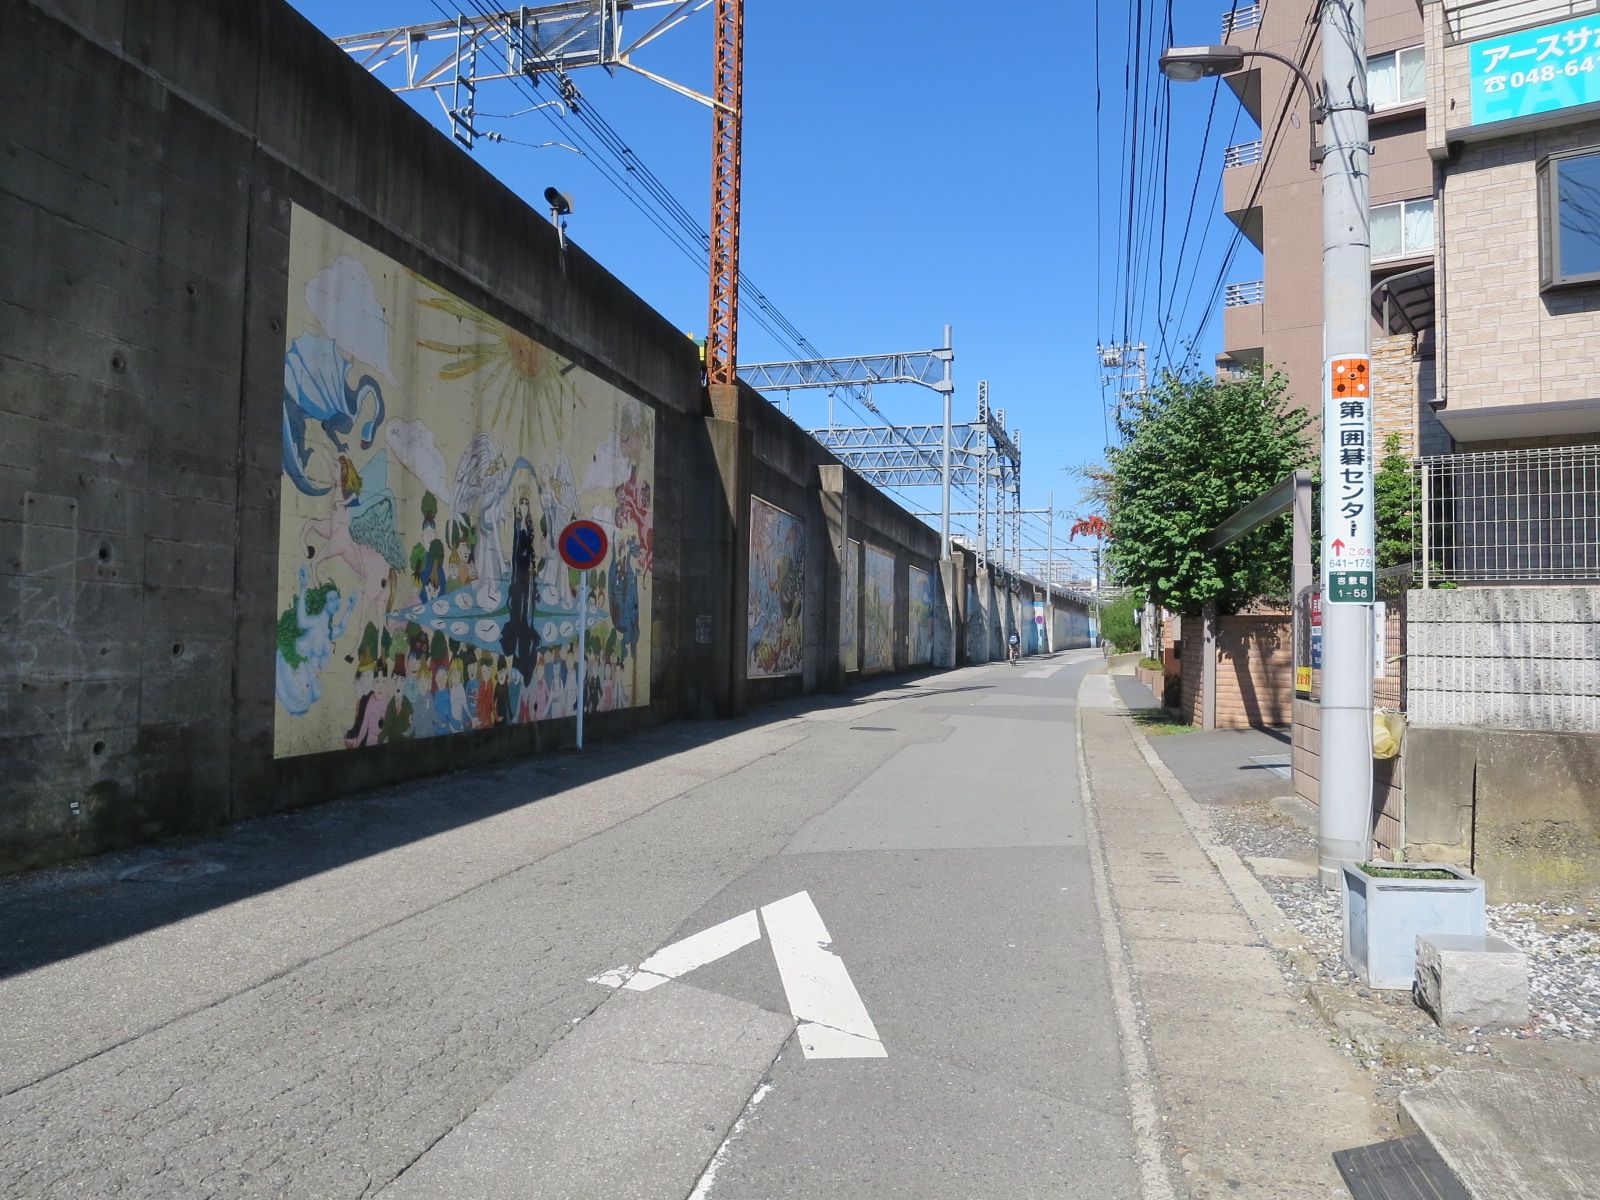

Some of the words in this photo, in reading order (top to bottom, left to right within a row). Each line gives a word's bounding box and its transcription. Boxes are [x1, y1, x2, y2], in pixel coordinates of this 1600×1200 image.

[1340, 401, 1365, 537] 第一囲碁センター
[1329, 558, 1374, 568] 641-175
